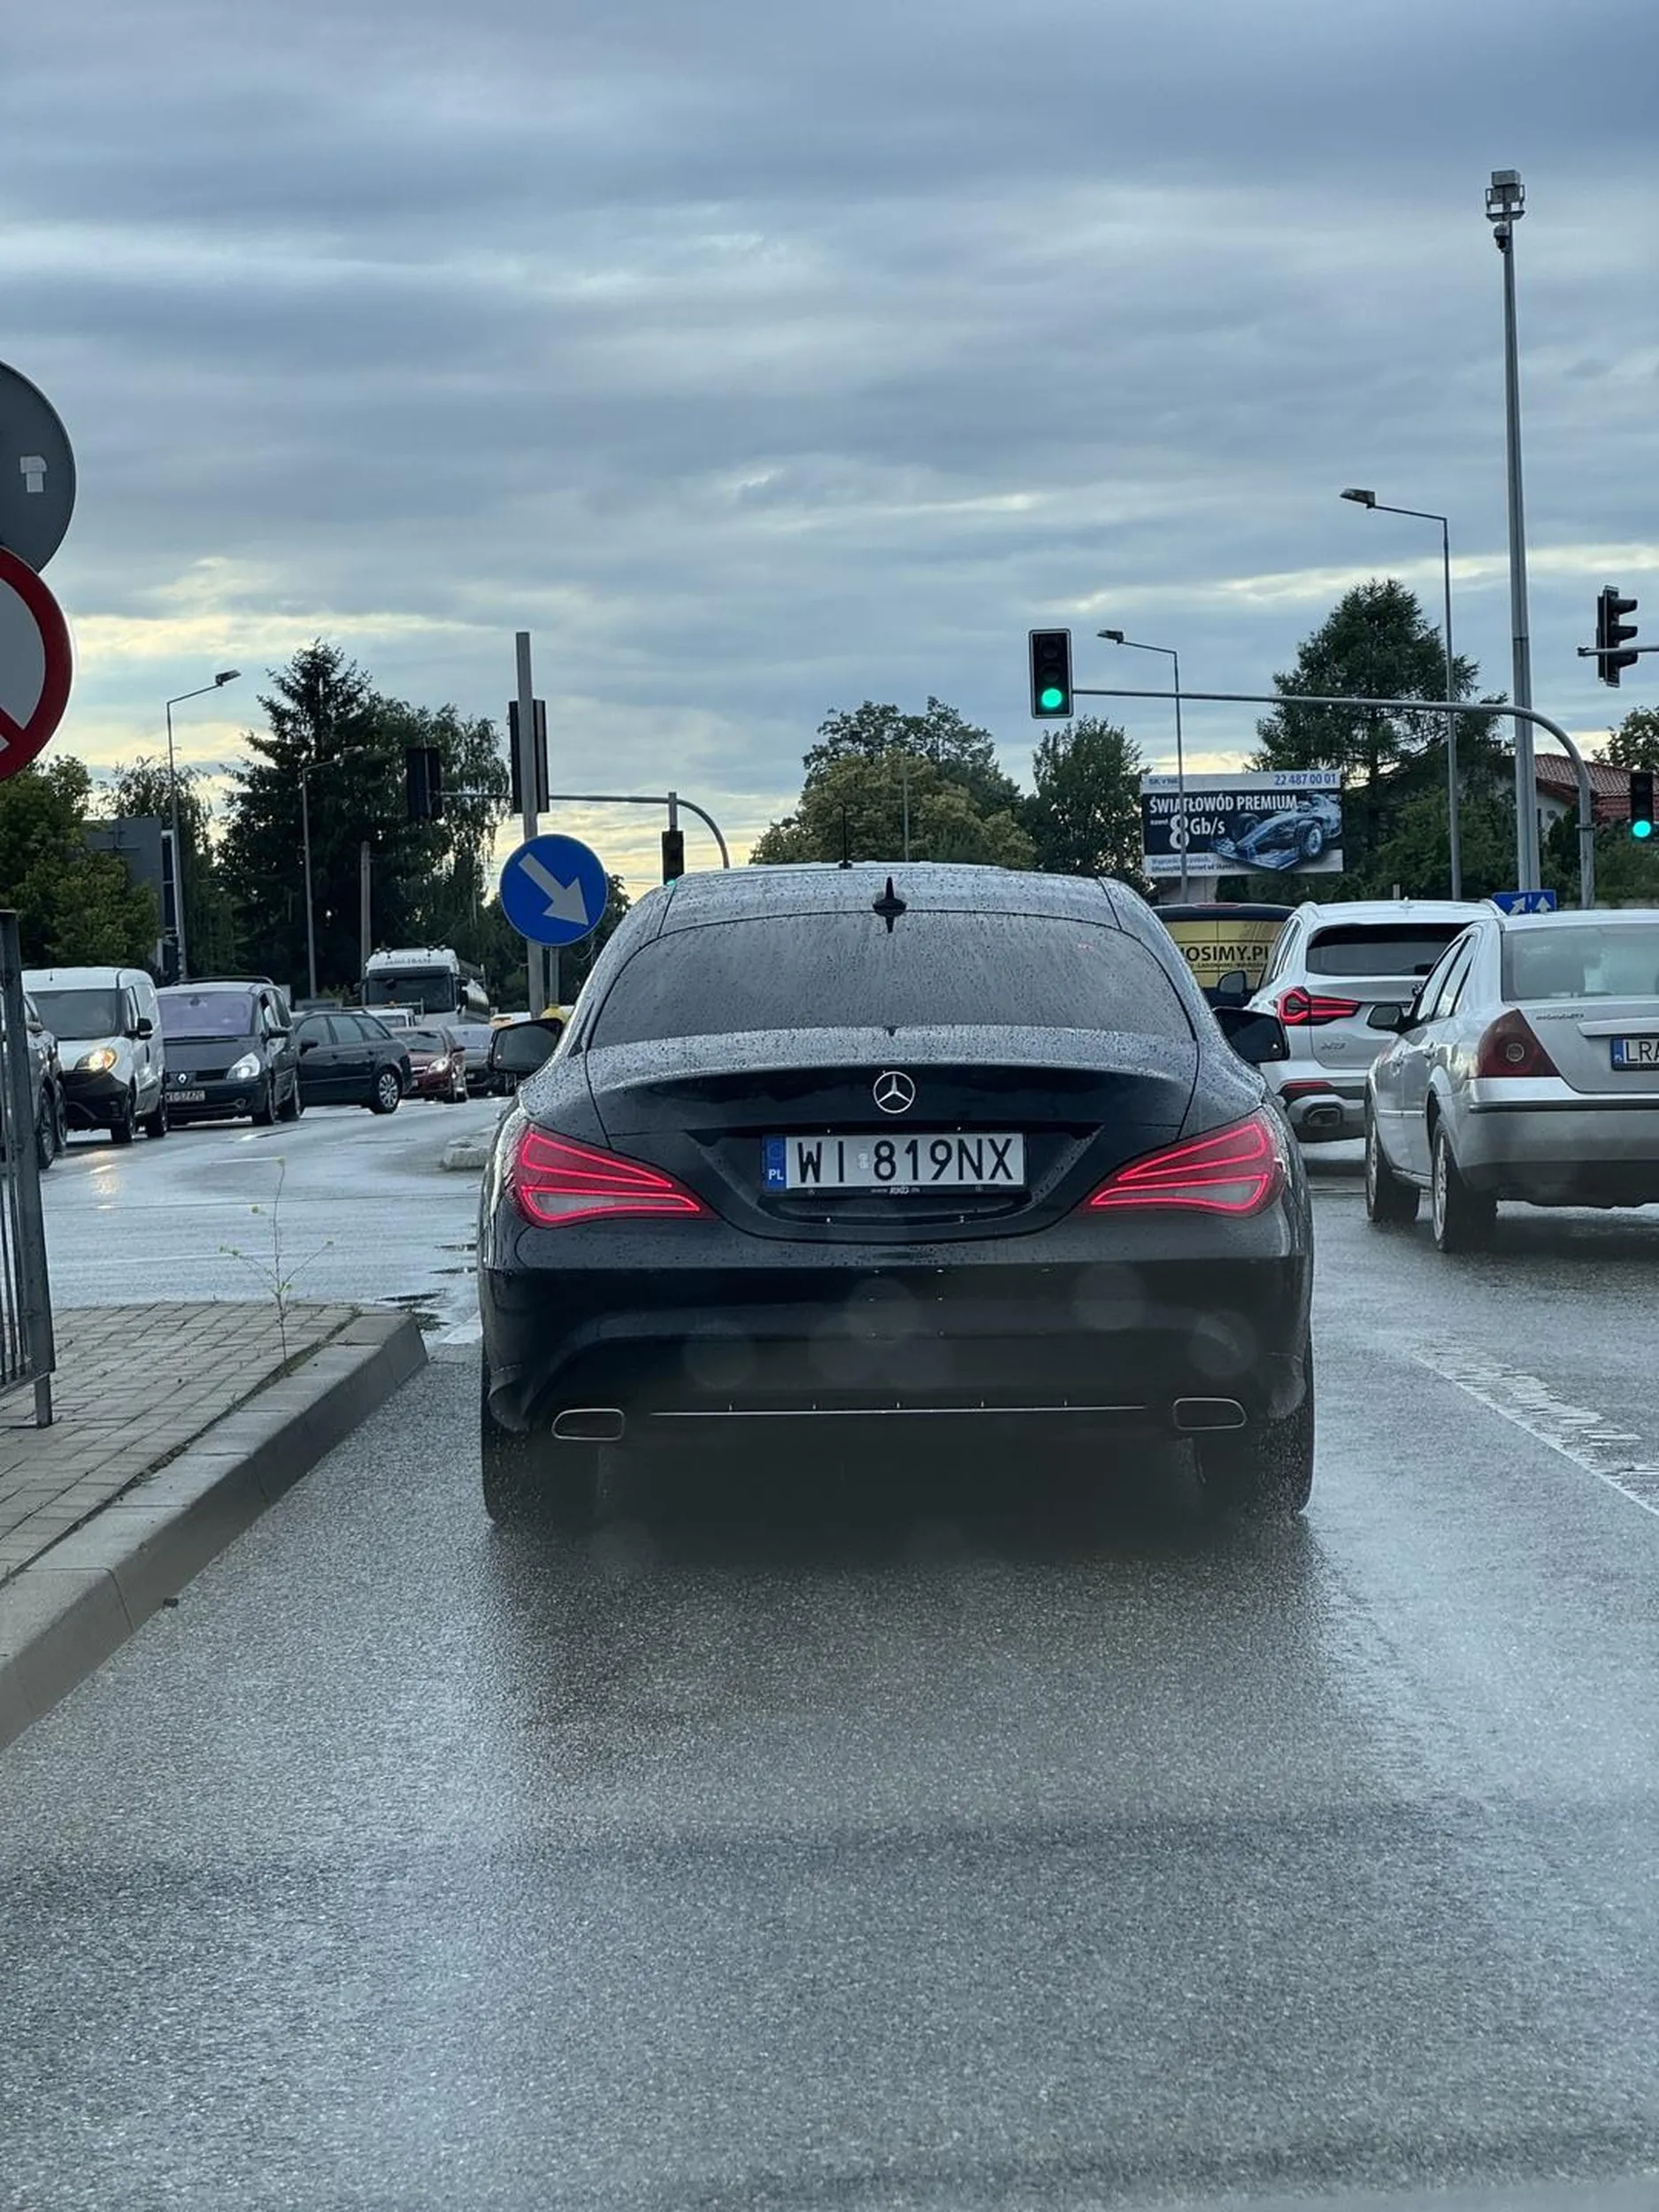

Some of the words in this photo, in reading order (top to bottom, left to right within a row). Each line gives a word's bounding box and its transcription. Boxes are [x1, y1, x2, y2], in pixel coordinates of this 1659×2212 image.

[1274, 774, 1286, 786] 22
[1289, 774, 1307, 786] 487
[1310, 773, 1323, 784] 00
[1325, 773, 1336, 784] 01
[1149, 793, 1234, 814] ŚWIATŁOWÓD
[1236, 795, 1298, 810] PREMIUM
[1169, 813, 1190, 849] 8
[1190, 817, 1225, 835] Gb/s
[797, 1141, 844, 1184] WI
[872, 1138, 1014, 1182] 819NX
[768, 1168, 784, 1180] PL
